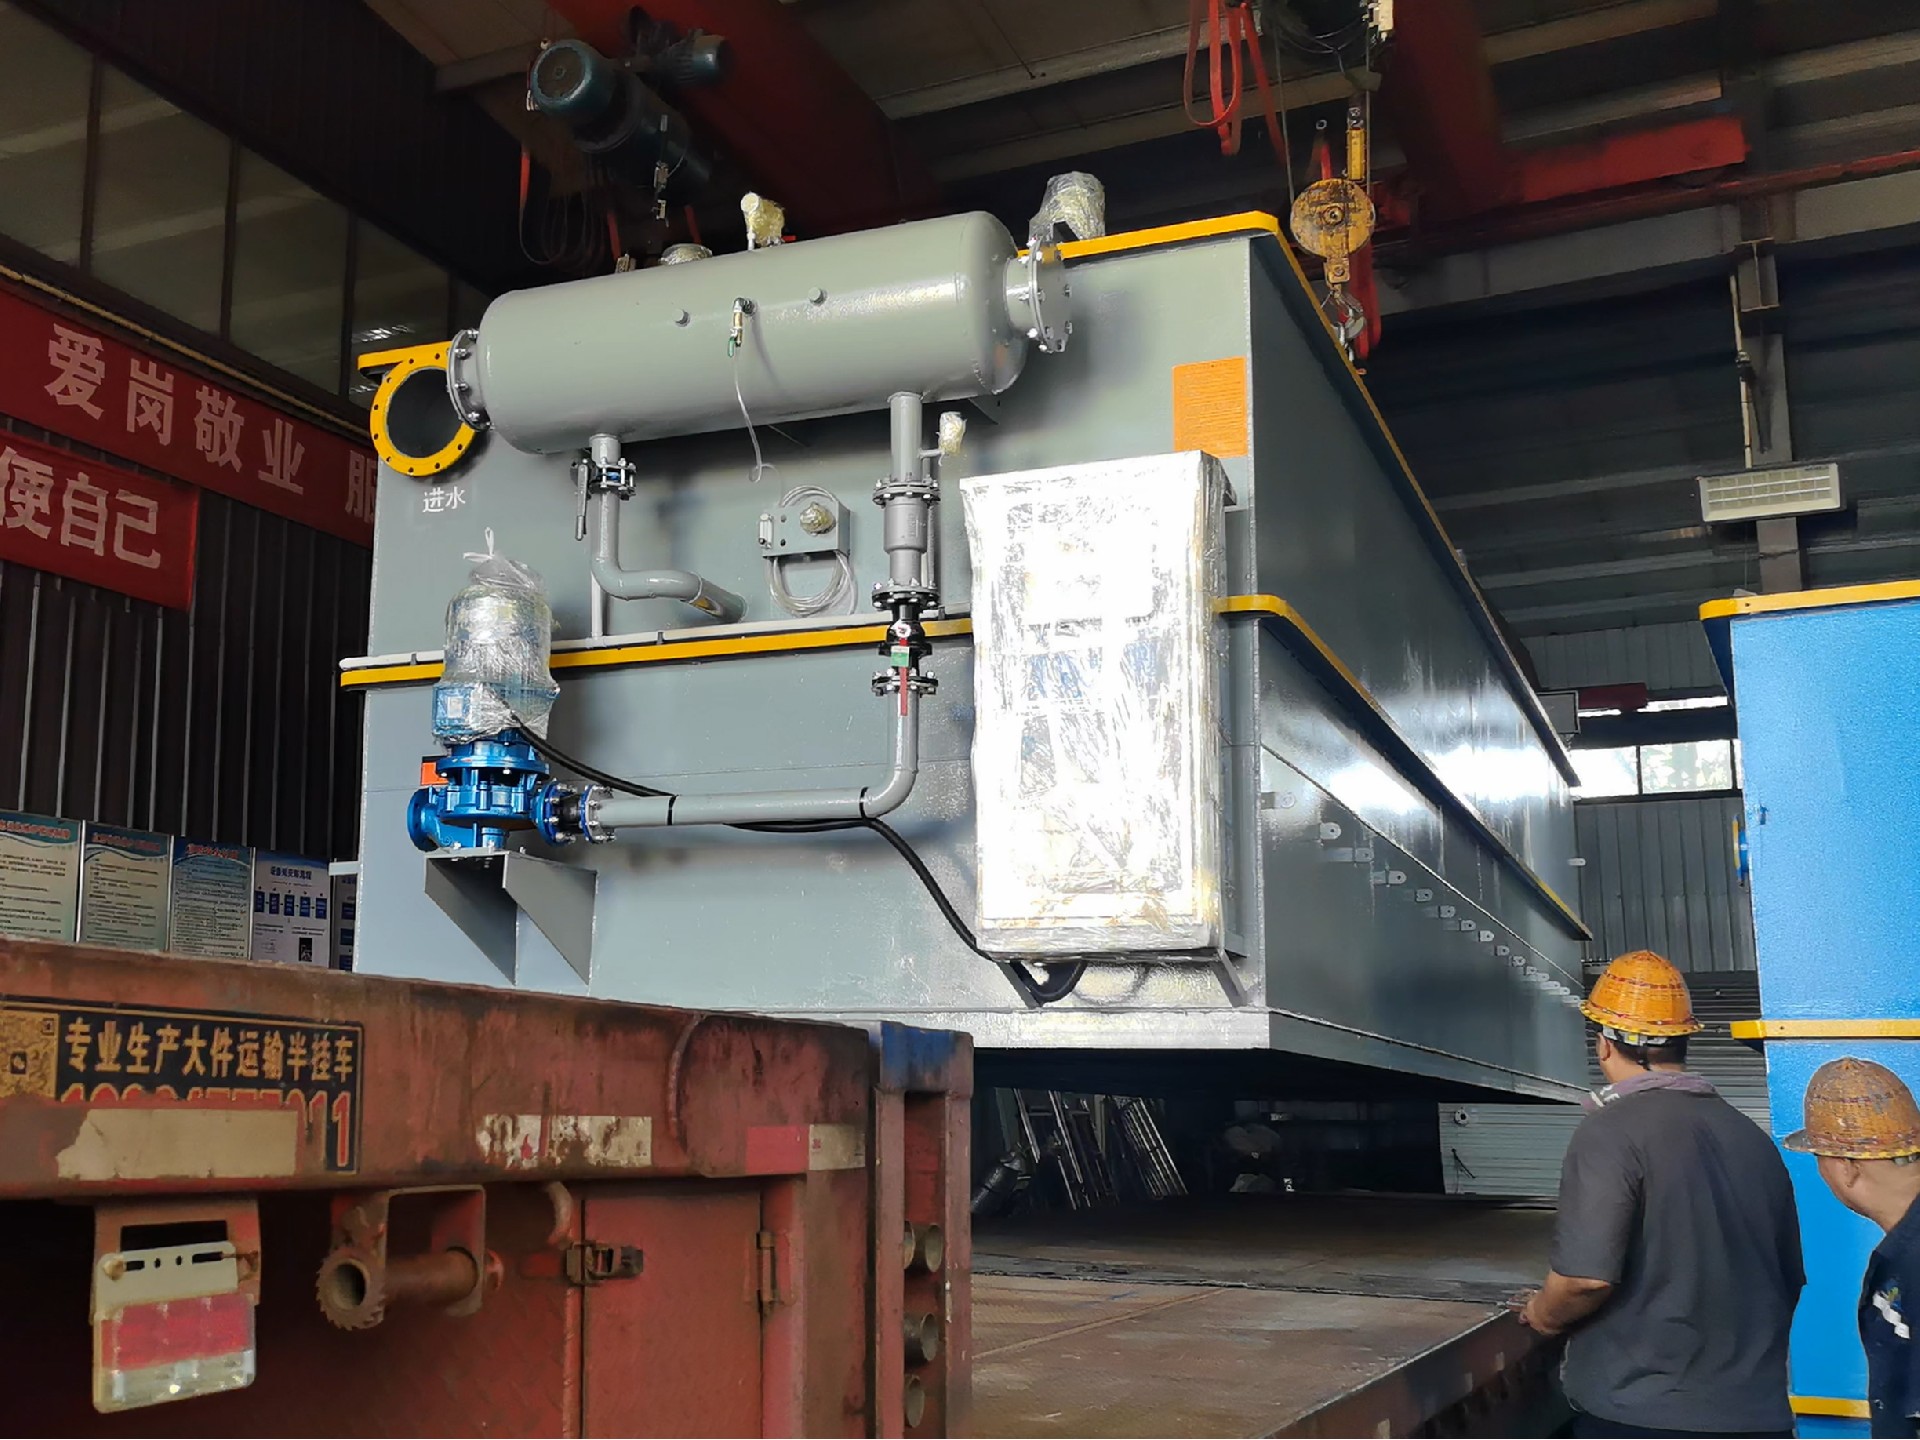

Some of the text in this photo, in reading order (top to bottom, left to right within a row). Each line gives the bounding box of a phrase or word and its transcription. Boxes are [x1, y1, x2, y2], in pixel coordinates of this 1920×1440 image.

[44, 322, 304, 495] 爱岗敬业
[0, 446, 161, 569] 便自己
[422, 486, 466, 513] 进水
[65, 1016, 354, 1083] 专业生产大件运输半挂车
